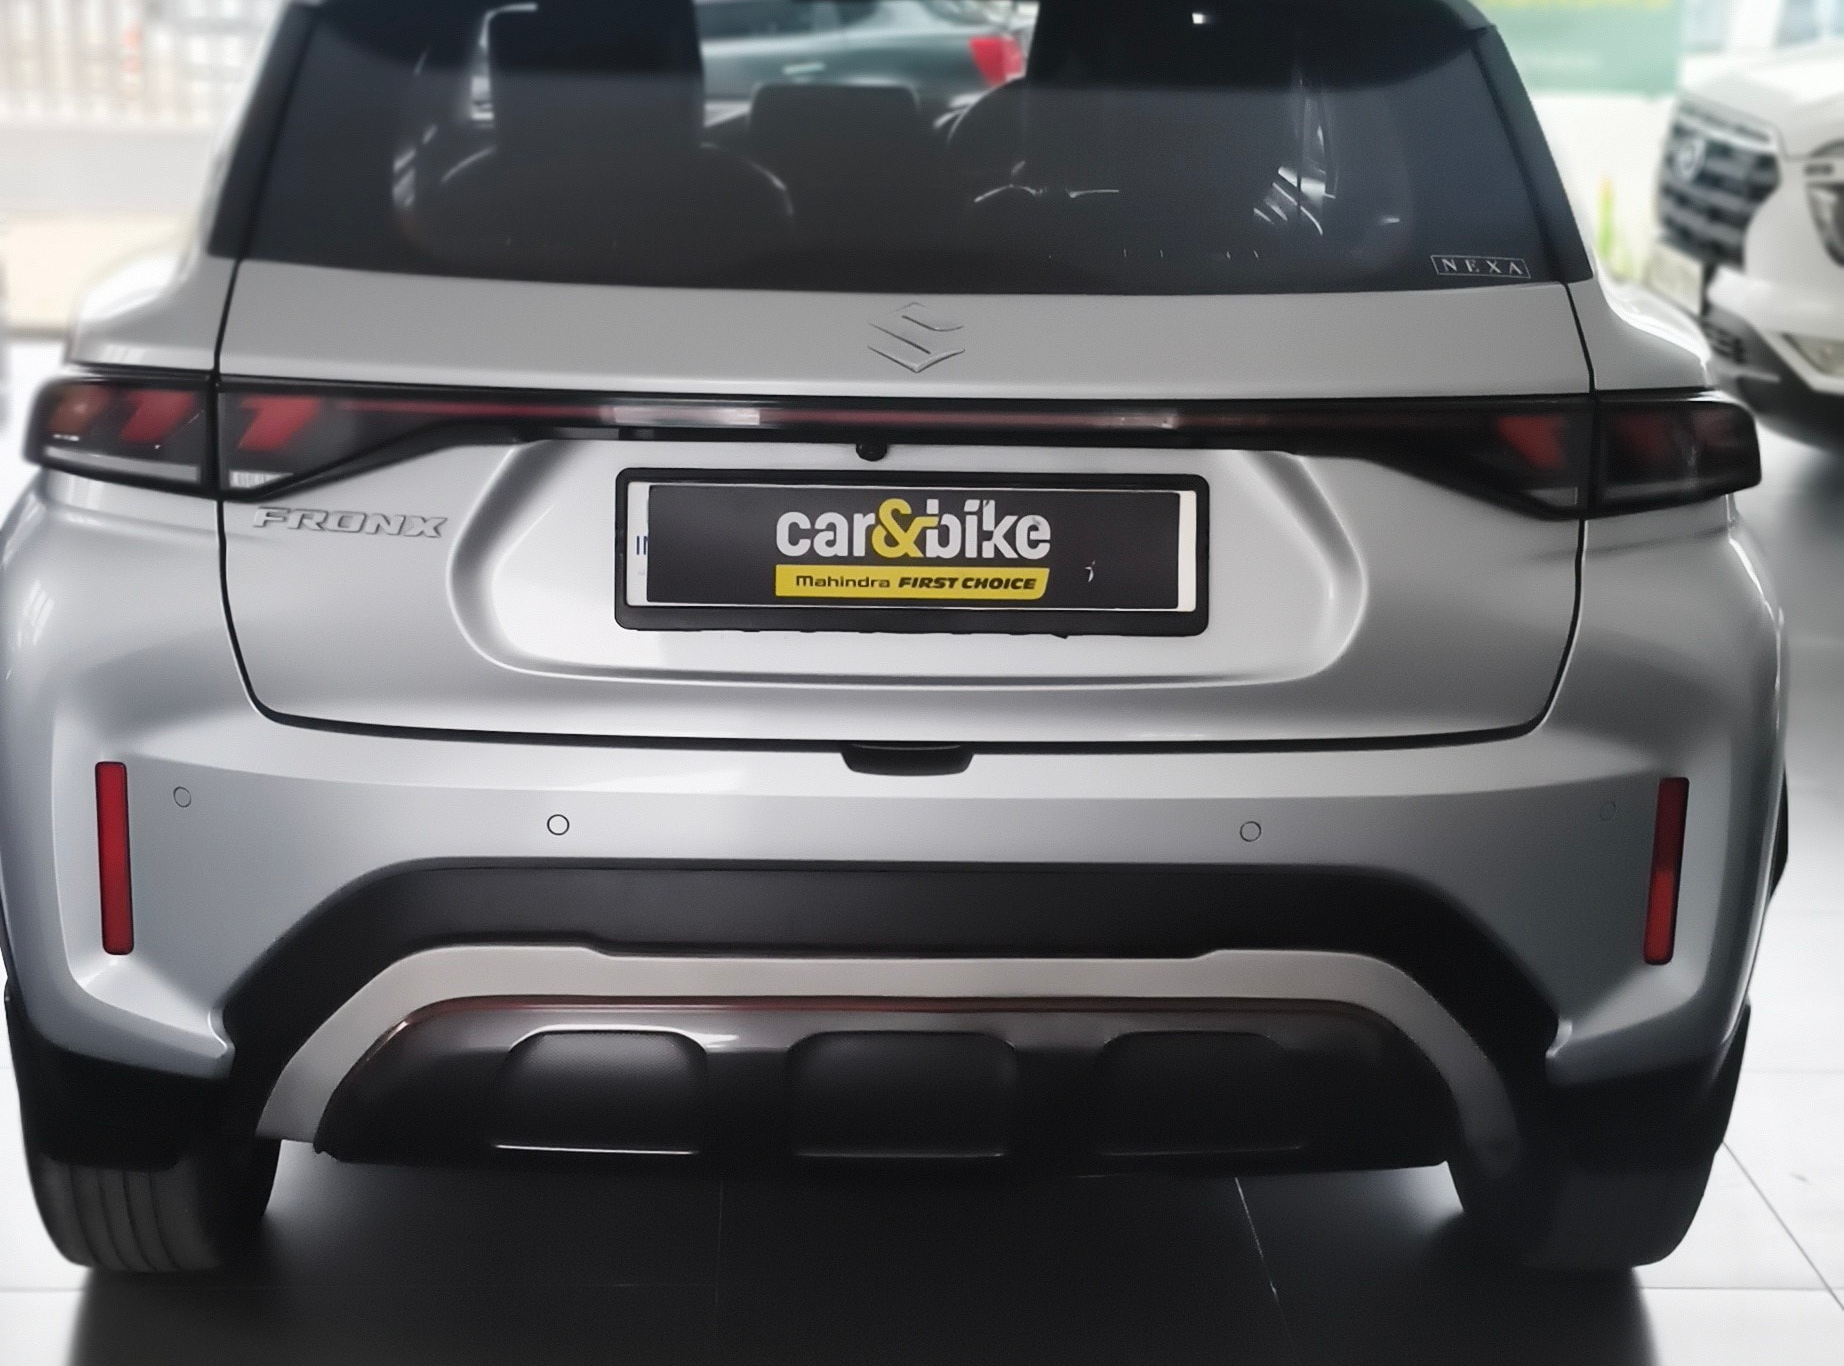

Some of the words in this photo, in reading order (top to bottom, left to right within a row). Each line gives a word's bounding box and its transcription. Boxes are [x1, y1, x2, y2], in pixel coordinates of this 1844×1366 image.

[1441, 258, 1524, 276] NEXA
[252, 506, 448, 538] FRONX
[776, 498, 1051, 560] car&bike
[795, 574, 891, 589] Mahindra
[898, 576, 963, 590] FIRST
[962, 577, 1037, 591] CHOICE
